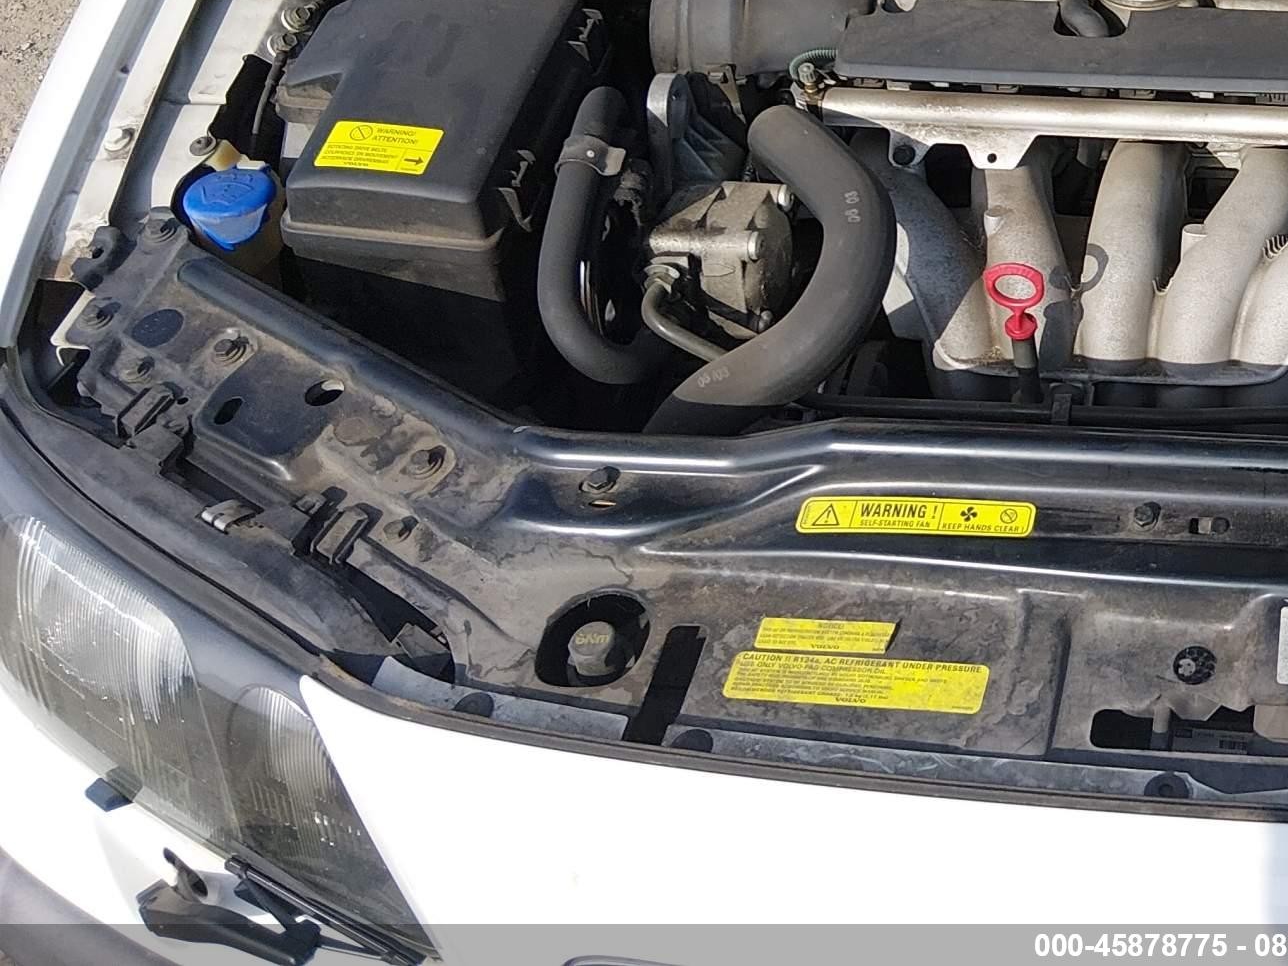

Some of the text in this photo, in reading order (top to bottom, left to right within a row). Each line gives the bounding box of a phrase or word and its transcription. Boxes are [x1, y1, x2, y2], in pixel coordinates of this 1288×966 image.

[376, 128, 416, 136] WARNING!
[372, 135, 418, 145] ATTENTION!
[861, 503, 938, 520] WARNING !
[860, 519, 913, 527] SELF-STARTING
[742, 653, 782, 662] CAUTION
[839, 658, 900, 668] REFRIGERANT
[902, 662, 932, 671] UNDER
[935, 664, 982, 673] PRESSURE
[821, 665, 872, 674] COMPRESSOR
